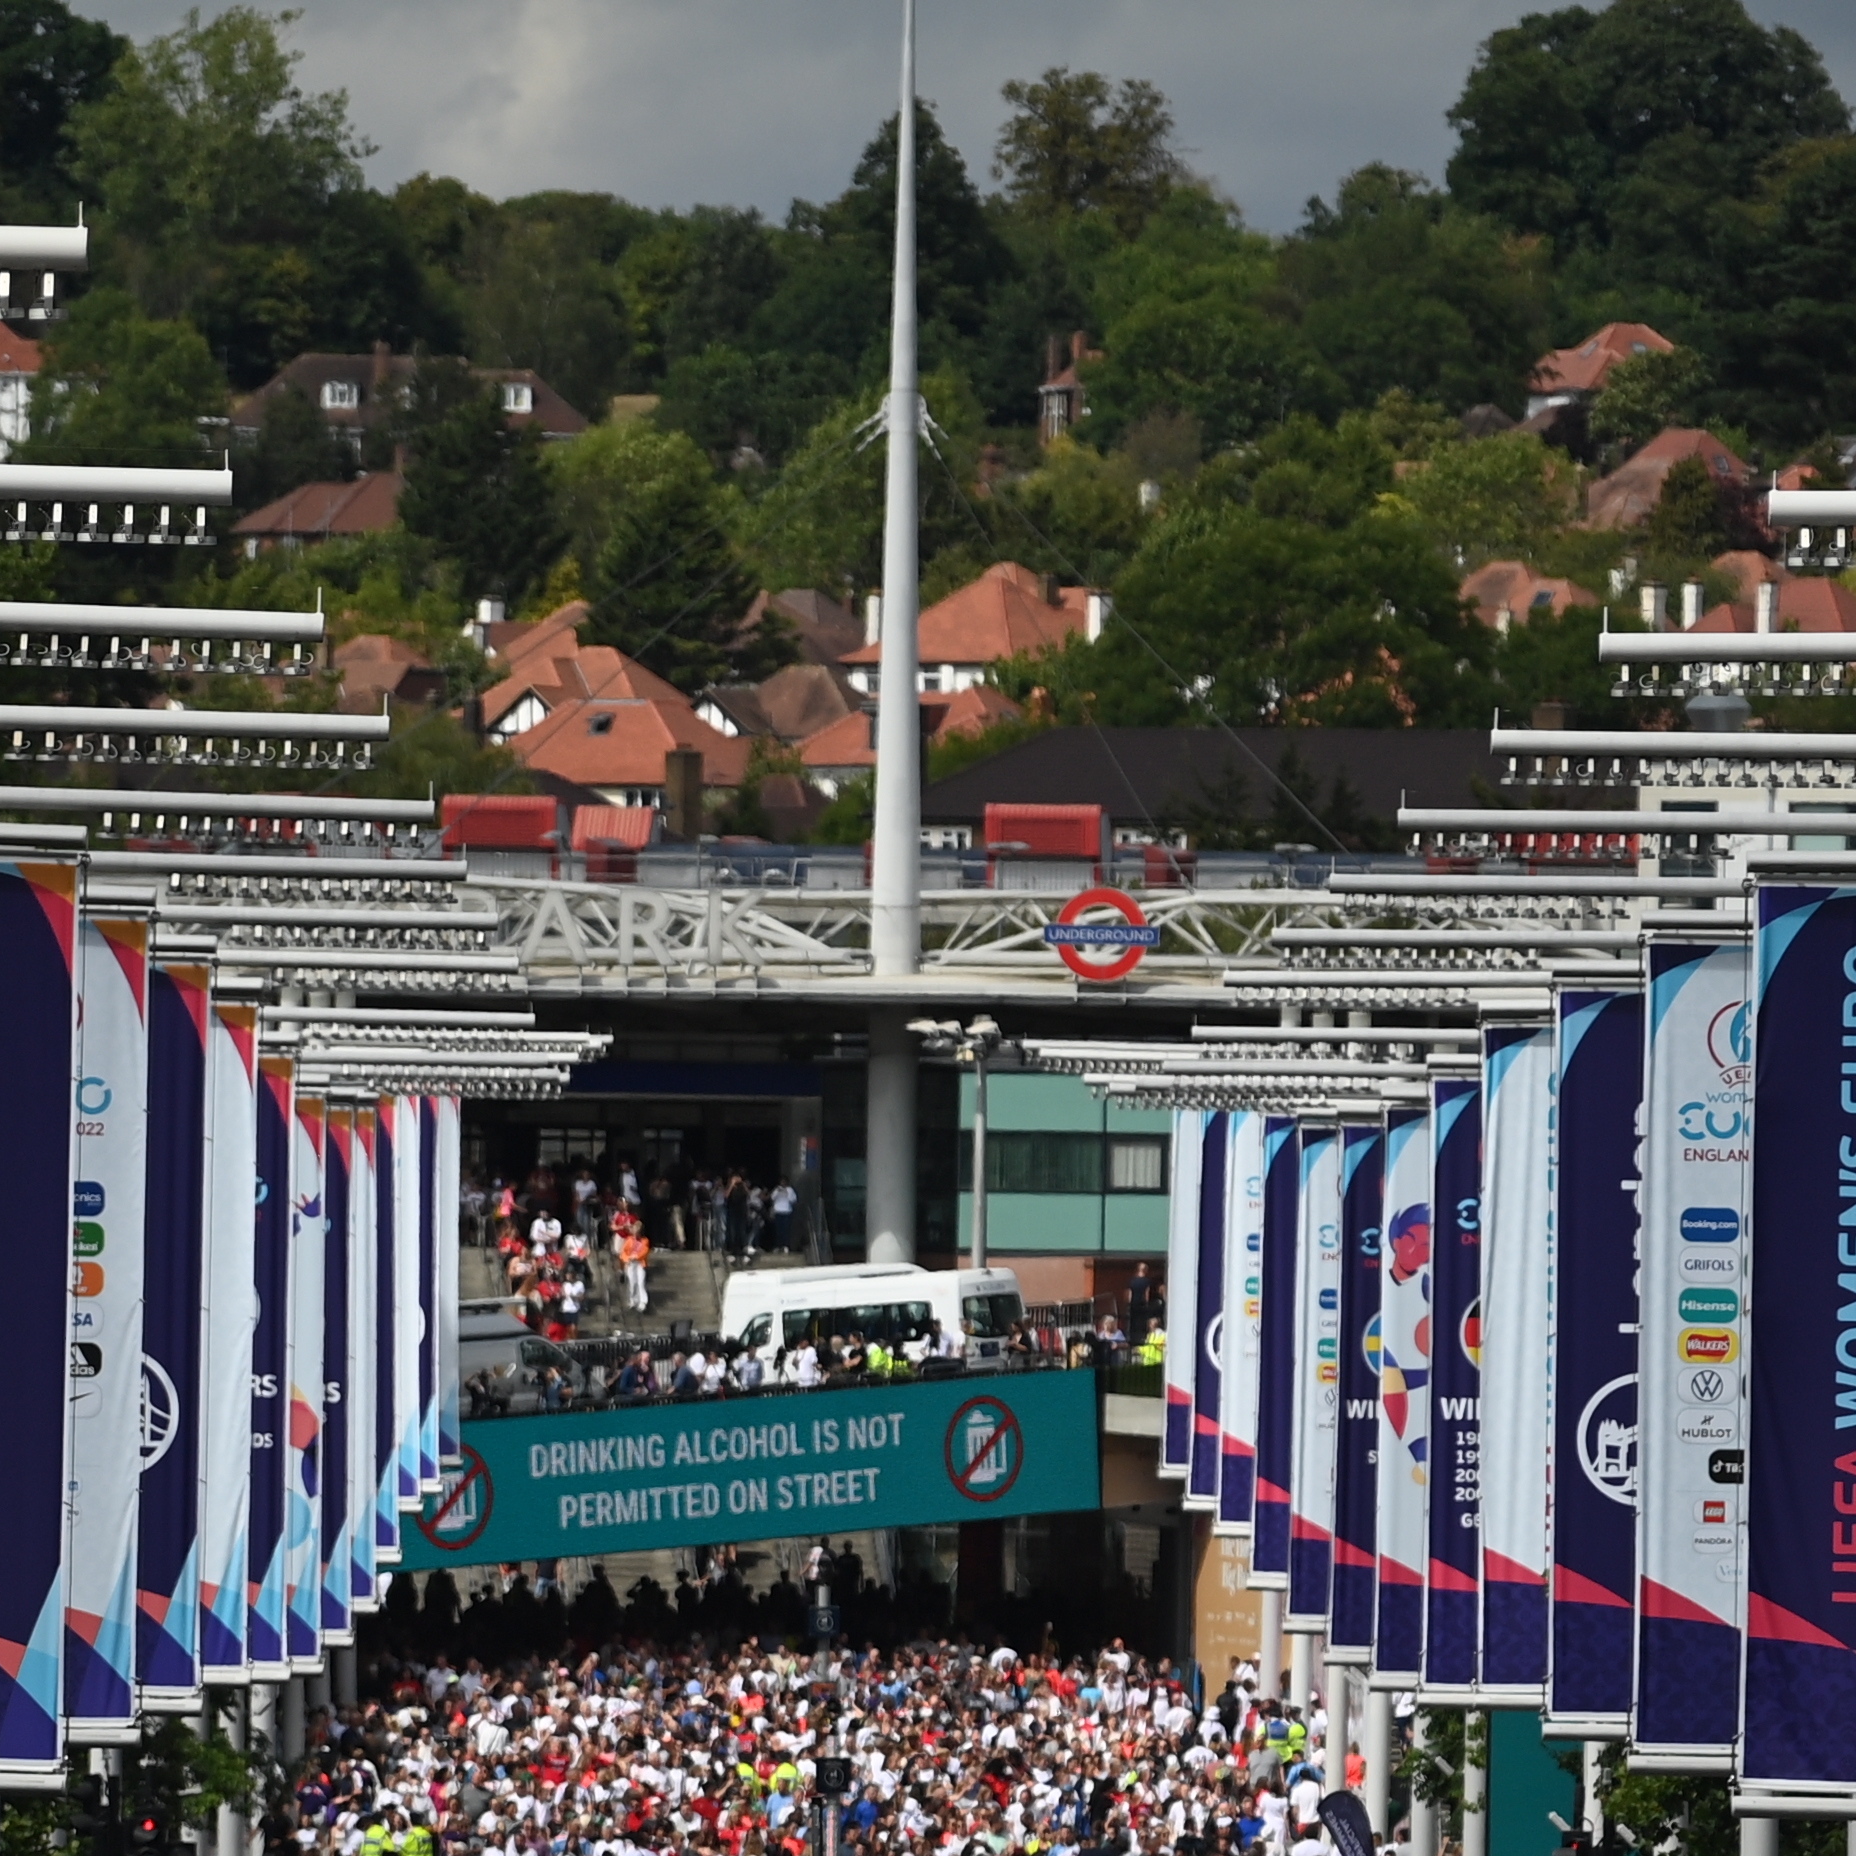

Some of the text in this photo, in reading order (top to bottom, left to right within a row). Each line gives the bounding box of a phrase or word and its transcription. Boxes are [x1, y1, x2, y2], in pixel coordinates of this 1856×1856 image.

[1048, 928, 1154, 942] UNDERGROUND
[1682, 1219, 1737, 1230] Booking.com
[1684, 1259, 1734, 1271] GRIFOLS
[1681, 1300, 1735, 1312] Hisense
[1687, 1339, 1730, 1352] WALKERS
[1682, 1428, 1732, 1439] HUBLOT
[529, 1412, 905, 1479] DRINKING ALCOHOL IS NOT
[560, 1467, 881, 1529] PERMITTED ON STREET
[1704, 1508, 1724, 1517] LEGO
